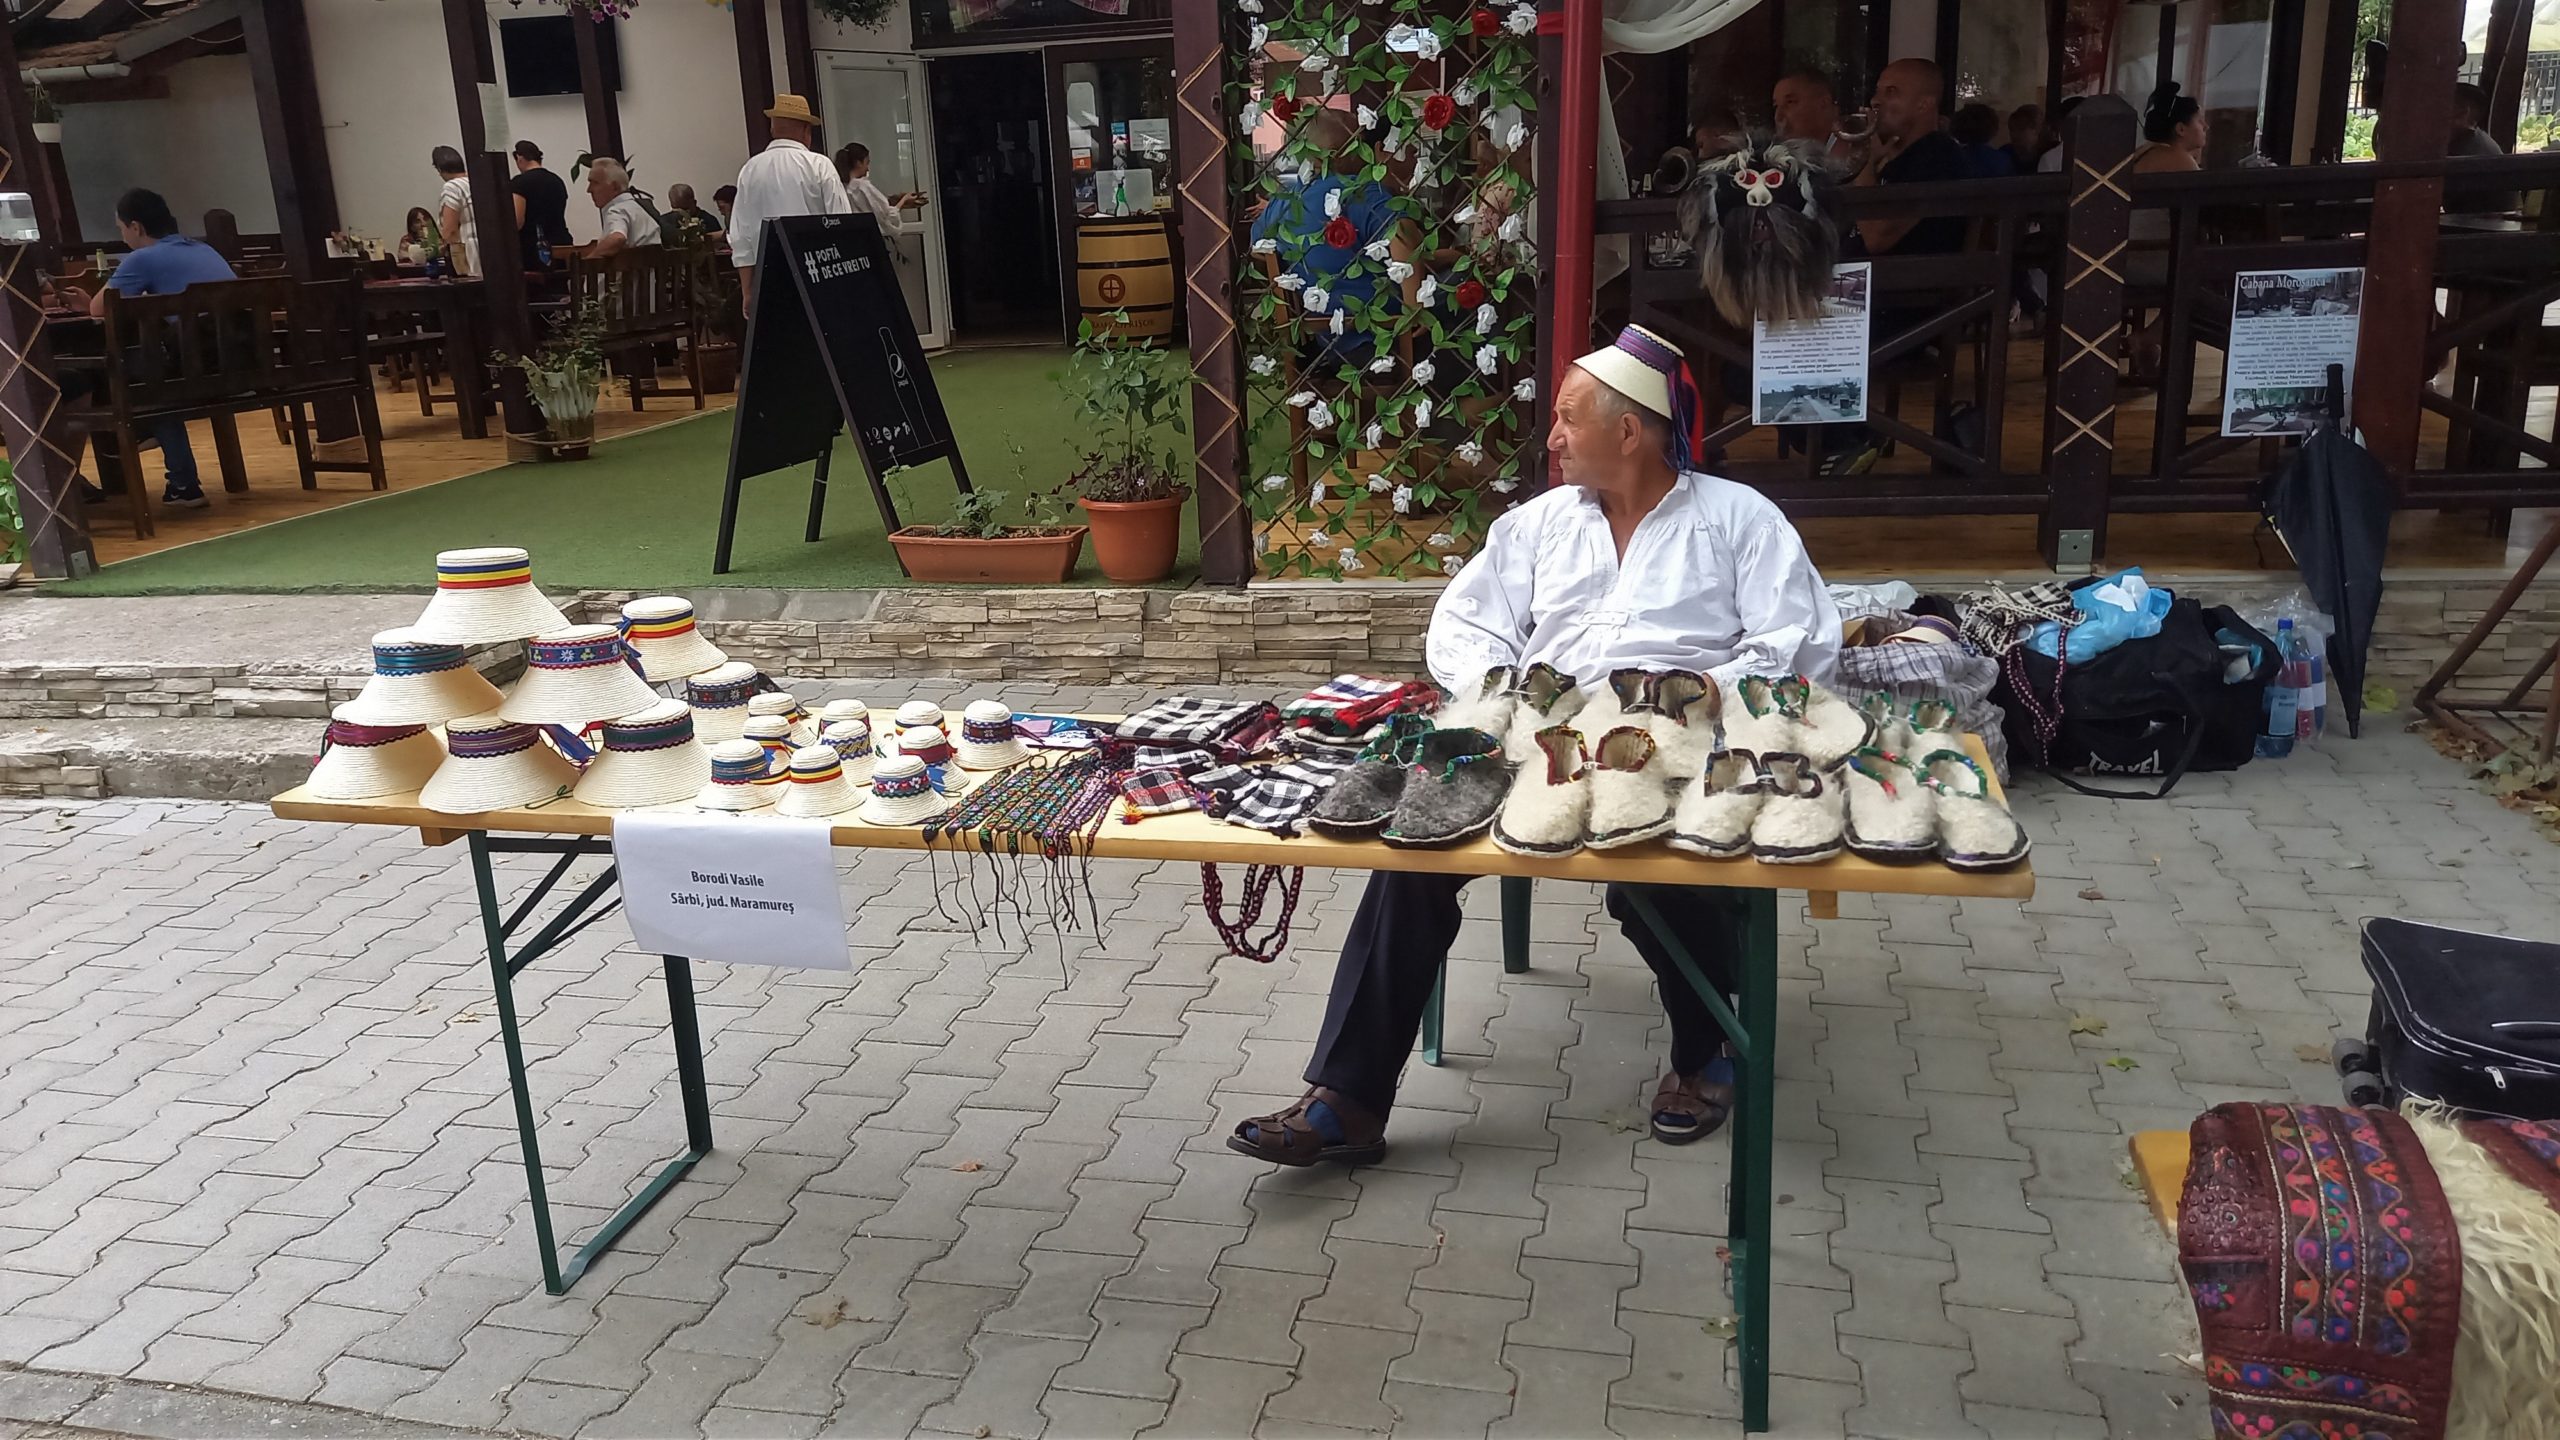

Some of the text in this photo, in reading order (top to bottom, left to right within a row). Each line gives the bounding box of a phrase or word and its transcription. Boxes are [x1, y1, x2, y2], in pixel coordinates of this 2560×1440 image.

[821, 256, 871, 279] DE CE VREI TU
[2240, 275, 2274, 289] Cabana
[691, 870, 765, 887] Borodi Vasile
[670, 892, 704, 907] Sârbi,
[706, 894, 728, 909] jud.
